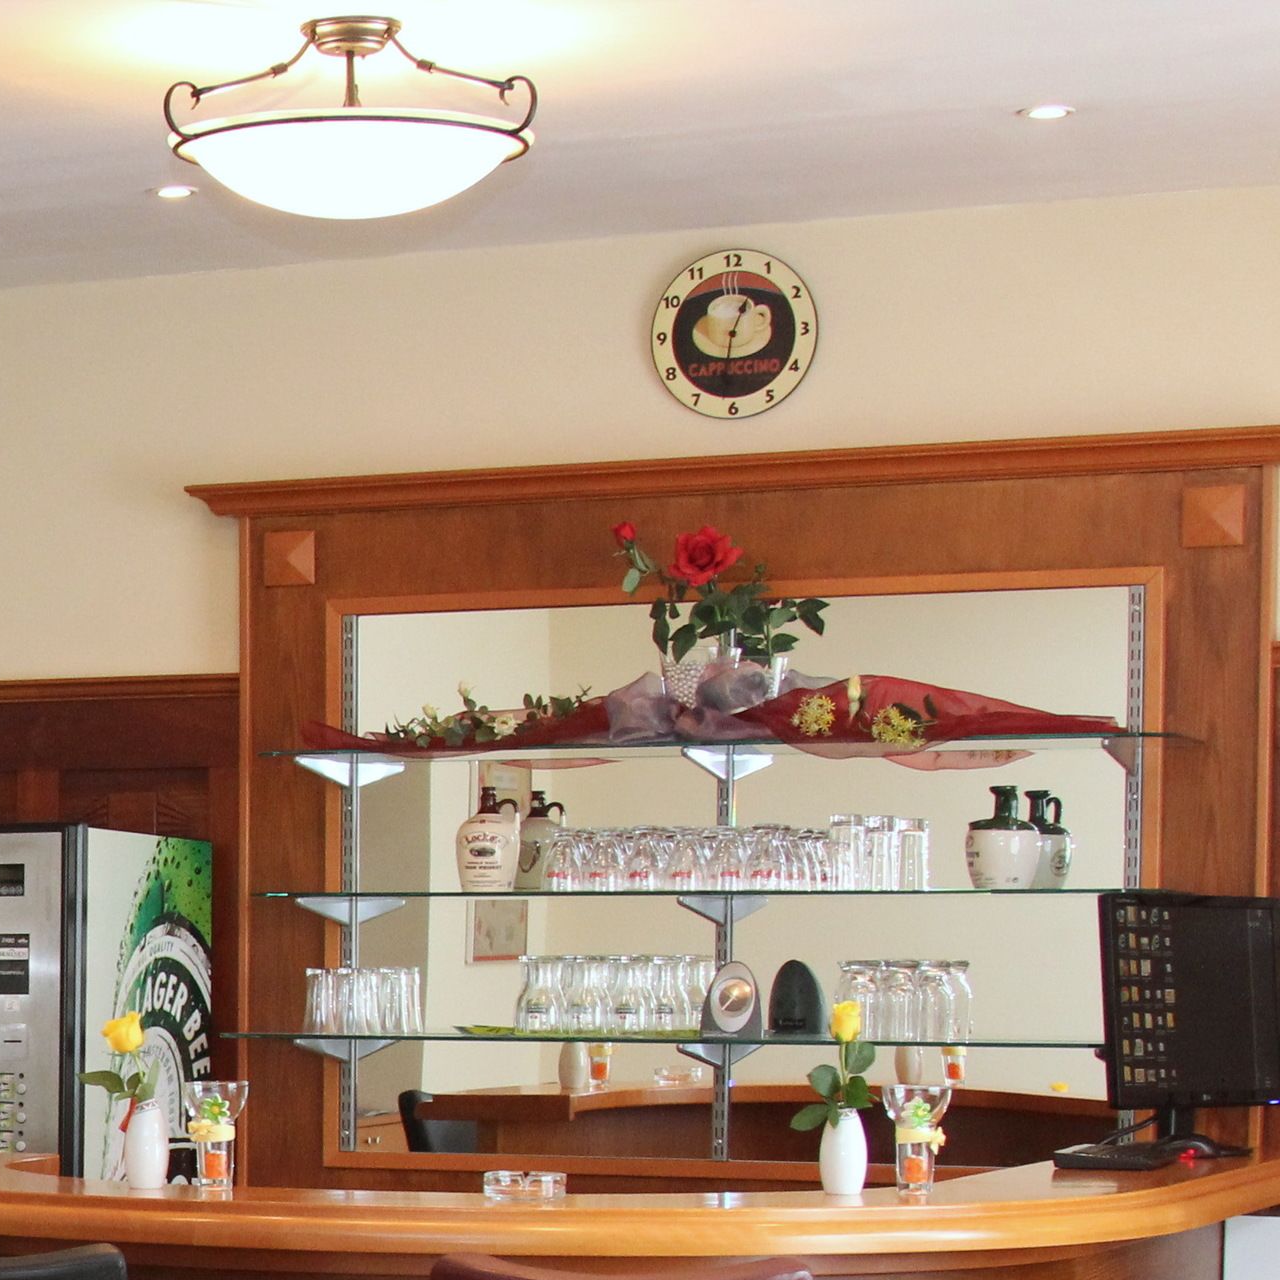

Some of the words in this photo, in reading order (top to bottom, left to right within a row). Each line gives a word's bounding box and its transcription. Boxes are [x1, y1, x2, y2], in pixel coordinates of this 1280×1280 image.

[723, 254, 742, 268] 12
[763, 261, 772, 274] 1
[688, 267, 704, 281] 11
[791, 285, 802, 299] 2
[663, 295, 681, 309] 10
[799, 321, 810, 336] 3
[656, 332, 667, 346] 9
[788, 358, 800, 373] 4
[665, 367, 677, 381] 8
[691, 393, 701, 407] 7
[765, 388, 775, 403] 5
[727, 401, 739, 416] 6
[182, 1008, 210, 1080] BEE
